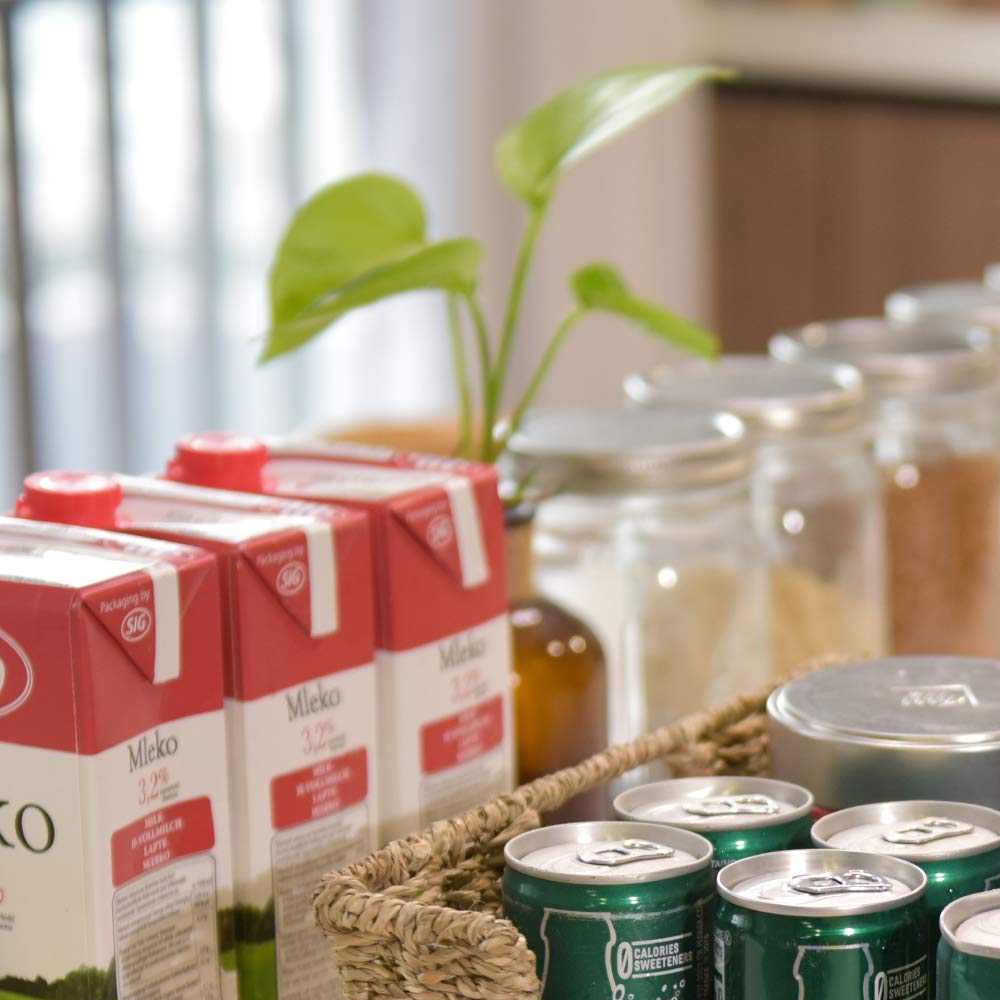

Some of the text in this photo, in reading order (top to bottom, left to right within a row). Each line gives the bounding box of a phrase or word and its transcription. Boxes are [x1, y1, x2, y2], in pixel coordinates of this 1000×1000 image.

[100, 590, 150, 616] Packaging by
[124, 611, 147, 636] SIG
[284, 682, 341, 722] Mleko
[127, 730, 178, 773] Mleko
[634, 942, 680, 959] CALORIES
[634, 950, 693, 972] SWEETENERS
[889, 965, 921, 988] CALORIES
